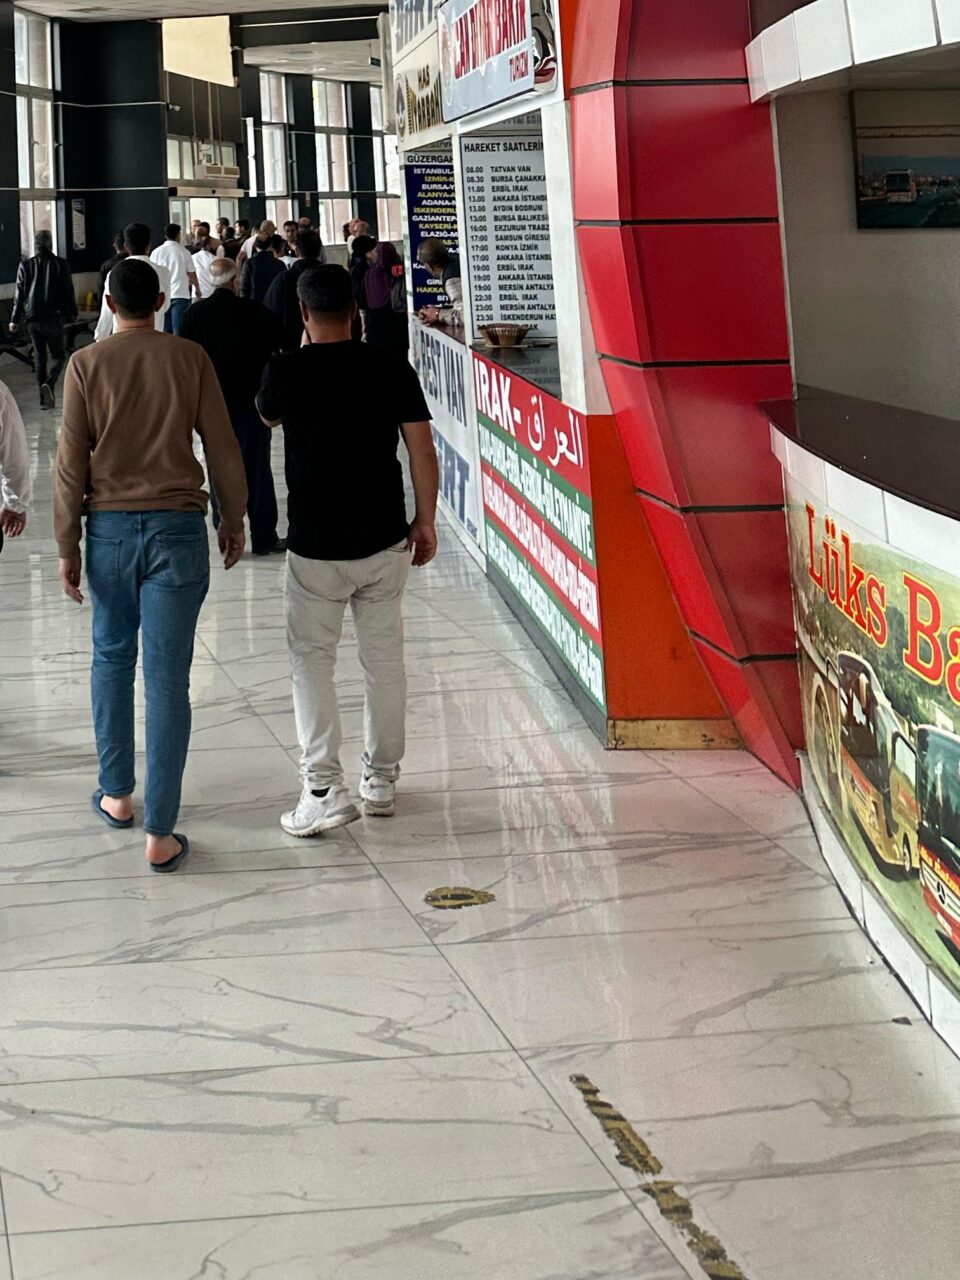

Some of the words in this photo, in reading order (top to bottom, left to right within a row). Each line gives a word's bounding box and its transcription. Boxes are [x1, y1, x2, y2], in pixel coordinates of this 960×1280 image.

[464, 142, 501, 152] HAREKET
[491, 184, 510, 192] ERBİL
[520, 243, 539, 251] İZMİR
[497, 263, 516, 271] ERBİL
[498, 283, 524, 291] MERSİN
[500, 303, 525, 311] MERSİN
[442, 343, 467, 428] VAN
[805, 500, 888, 648] Lüks
